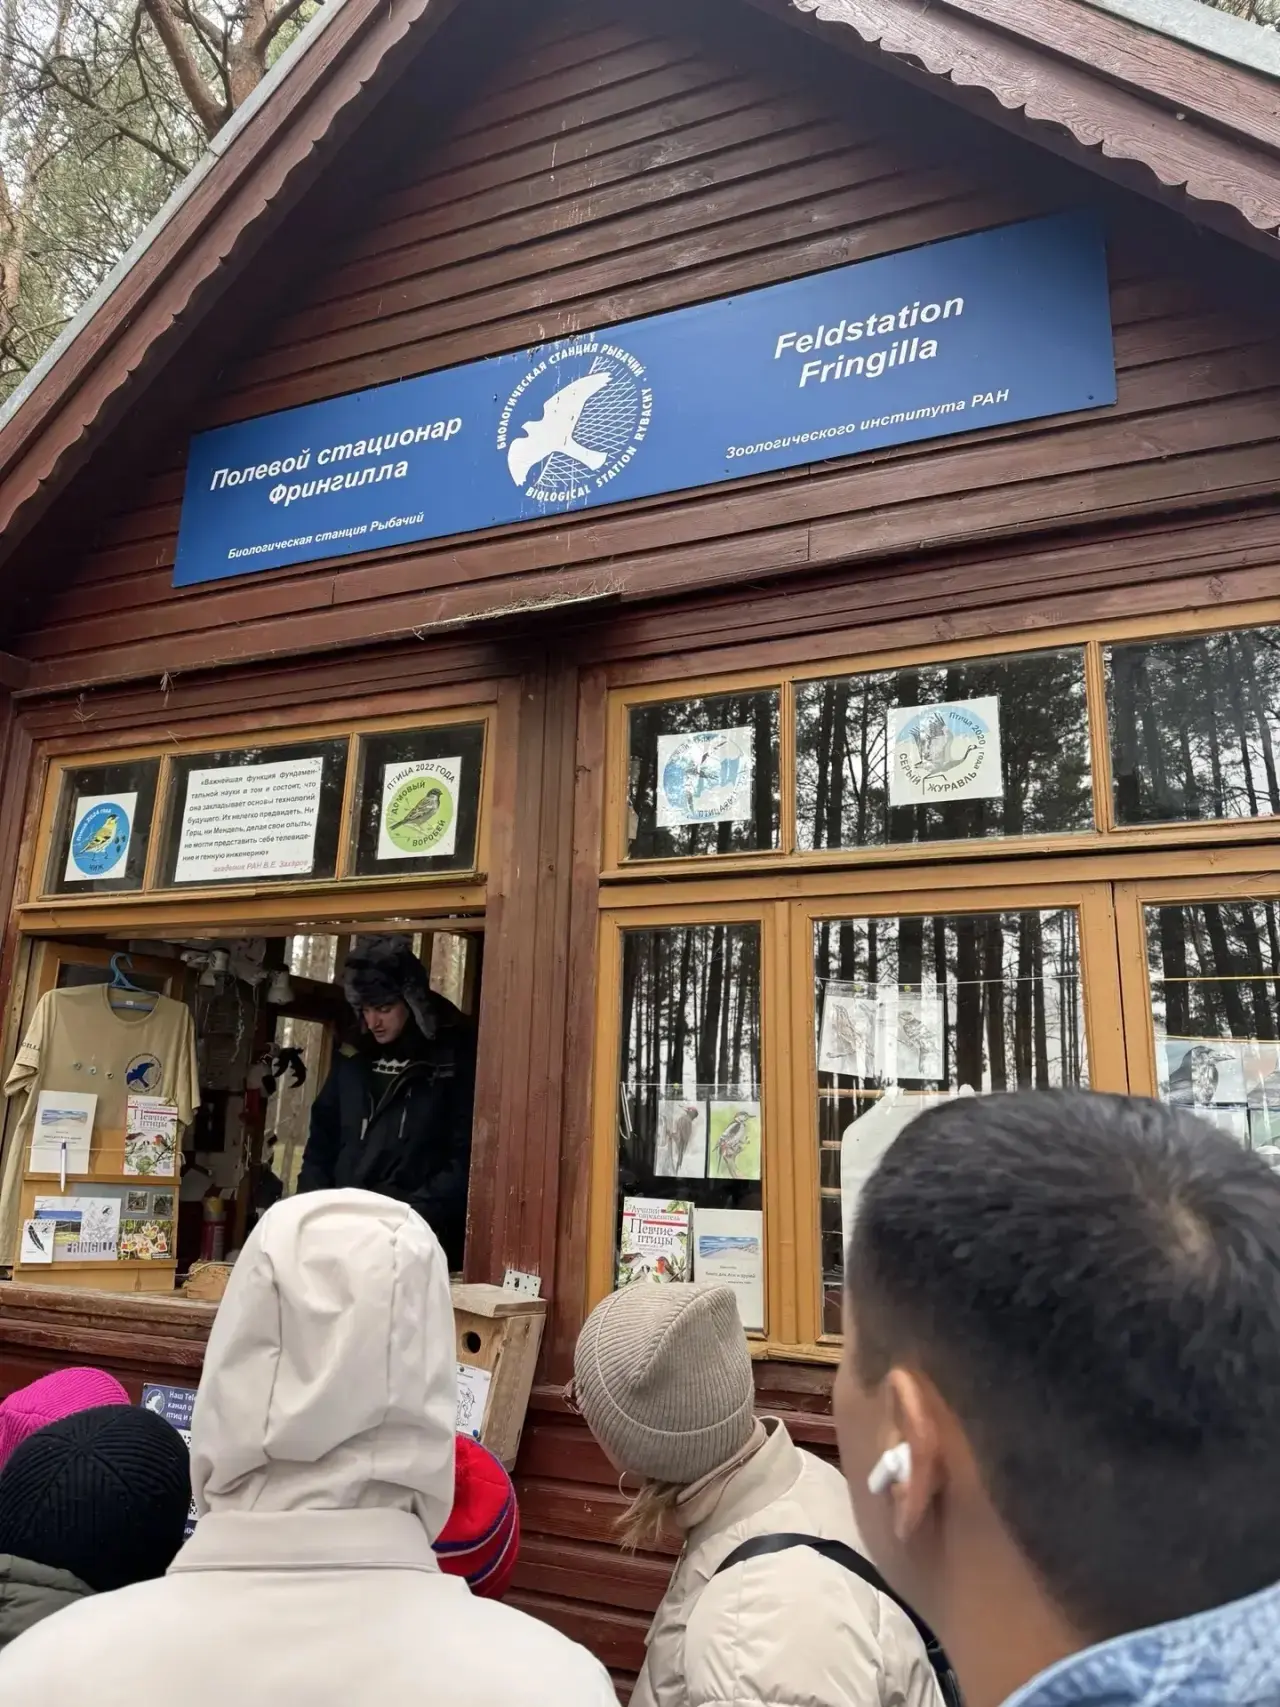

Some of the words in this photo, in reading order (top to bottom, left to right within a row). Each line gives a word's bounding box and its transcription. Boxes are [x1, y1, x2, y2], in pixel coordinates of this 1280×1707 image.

[773, 296, 964, 360] Feldstation
[798, 336, 938, 388] Fringilla
[497, 361, 547, 450] БИОЛОГИЧЕСКАЯ
[548, 342, 599, 365] СТАНЦИЯ
[600, 343, 647, 377] РЫБАЧИЙ
[725, 420, 855, 460] Зоологического
[860, 398, 965, 431] института
[971, 389, 1010, 408] РАН
[210, 447, 311, 492] Полевой
[316, 416, 463, 467] стационар
[525, 485, 591, 502] BIOLOGICAL
[596, 446, 637, 488] STATION
[634, 387, 653, 441] RYBACHY
[269, 458, 408, 507] Фрингилла
[227, 533, 313, 560] Биологическая
[315, 523, 367, 546] станция
[370, 512, 425, 535] Рыбачий
[949, 711, 973, 727] Птица
[972, 725, 986, 745] 2020
[246, 773, 276, 782] функция
[280, 770, 317, 779] фундамен-
[387, 767, 414, 790] ПТИЦА
[416, 763, 435, 772] 2022
[435, 765, 455, 783] ГОДА
[900, 753, 922, 786] СЕРЫЙ
[927, 772, 977, 792] ЖУРАВЛЬ
[191, 790, 218, 799] тальной
[220, 789, 240, 797] науки
[272, 783, 301, 791] состоит,
[391, 780, 426, 815] ДОМОВЫЙ
[202, 801, 246, 811] закладывает
[275, 794, 315, 803] технологий
[232, 812, 258, 821] нелегко
[246, 824, 267, 832] делая
[412, 819, 446, 847] ВОРОБЕЙ
[214, 838, 257, 848] представить
[259, 835, 275, 843] себе
[246, 862, 263, 870] РАН
[630, 1218, 674, 1236] Певчие
[67, 1241, 116, 1253] FRINGILLA
[637, 1234, 673, 1246] птицы
[167, 1402, 186, 1411] канал
[169, 1391, 184, 1400] Наш
[166, 1412, 182, 1421] птиц
